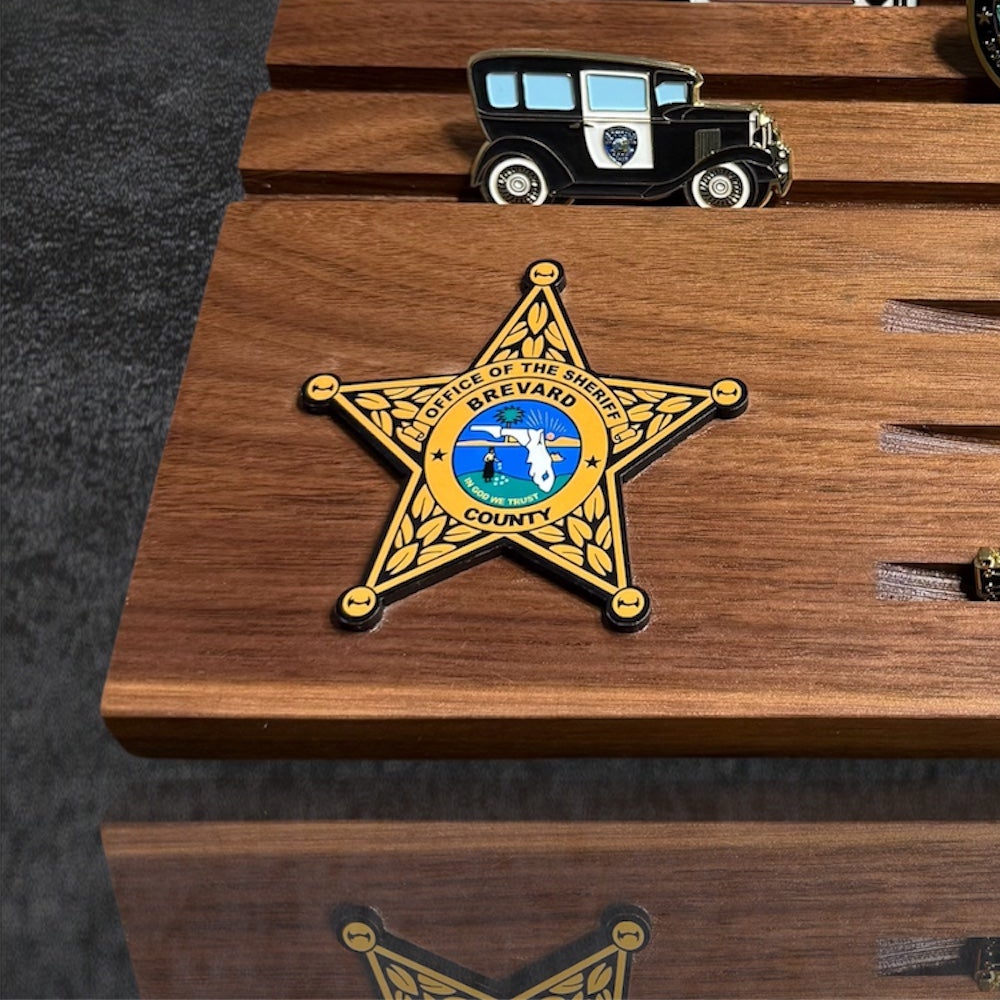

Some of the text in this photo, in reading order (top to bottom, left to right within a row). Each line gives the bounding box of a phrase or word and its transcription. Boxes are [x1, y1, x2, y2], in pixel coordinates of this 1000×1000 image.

[426, 362, 621, 421] OFFICE OF THE SHERIFF
[467, 381, 577, 411] BREVARD
[464, 477, 540, 506] IN GOD WE TRUST
[463, 507, 552, 527] COUNTY
